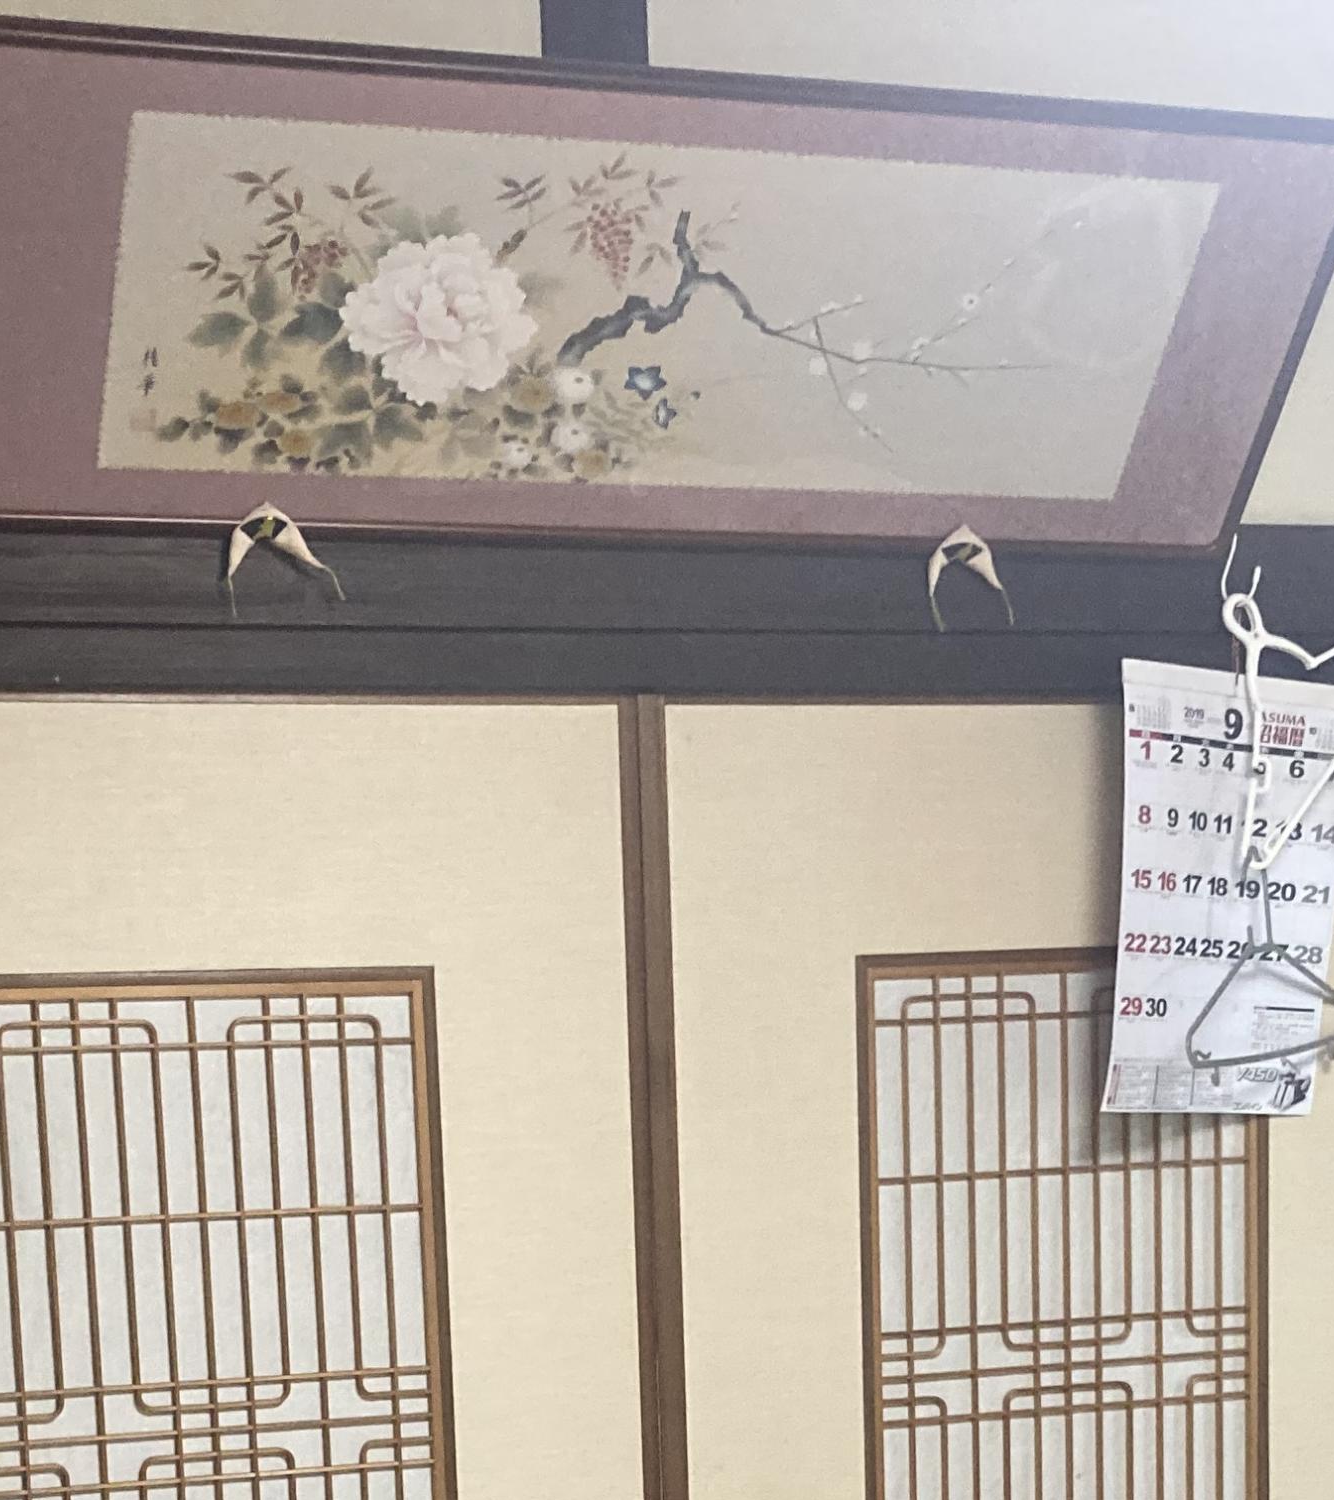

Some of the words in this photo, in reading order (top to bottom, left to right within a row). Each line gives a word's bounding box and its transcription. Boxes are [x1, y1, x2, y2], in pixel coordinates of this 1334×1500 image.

[1224, 708, 1244, 739] 9
[1140, 740, 1151, 760] 1
[1170, 744, 1184, 764] 2
[1198, 748, 1210, 767] 3
[1222, 752, 1234, 771] 4
[1289, 760, 1305, 778] 6
[1138, 805, 1151, 824] 8
[1167, 808, 1179, 828] 9
[1188, 811, 1208, 831] 10
[1213, 814, 1233, 834] 11
[1241, 818, 1268, 838] 2
[1275, 820, 1302, 840] 3
[1131, 869, 1152, 889] 15
[1157, 872, 1177, 892] 16
[1182, 874, 1202, 894] 17
[1207, 877, 1228, 896] 18
[1235, 880, 1261, 899] 19
[1267, 882, 1296, 902] 20
[1301, 885, 1330, 904] 21
[1124, 932, 1147, 953] 22
[1149, 935, 1172, 954] 23
[1174, 936, 1197, 956] 24
[1200, 938, 1224, 958] 25
[1294, 945, 1323, 964] 28
[1120, 996, 1143, 1016] 29
[1145, 997, 1167, 1017] 30
